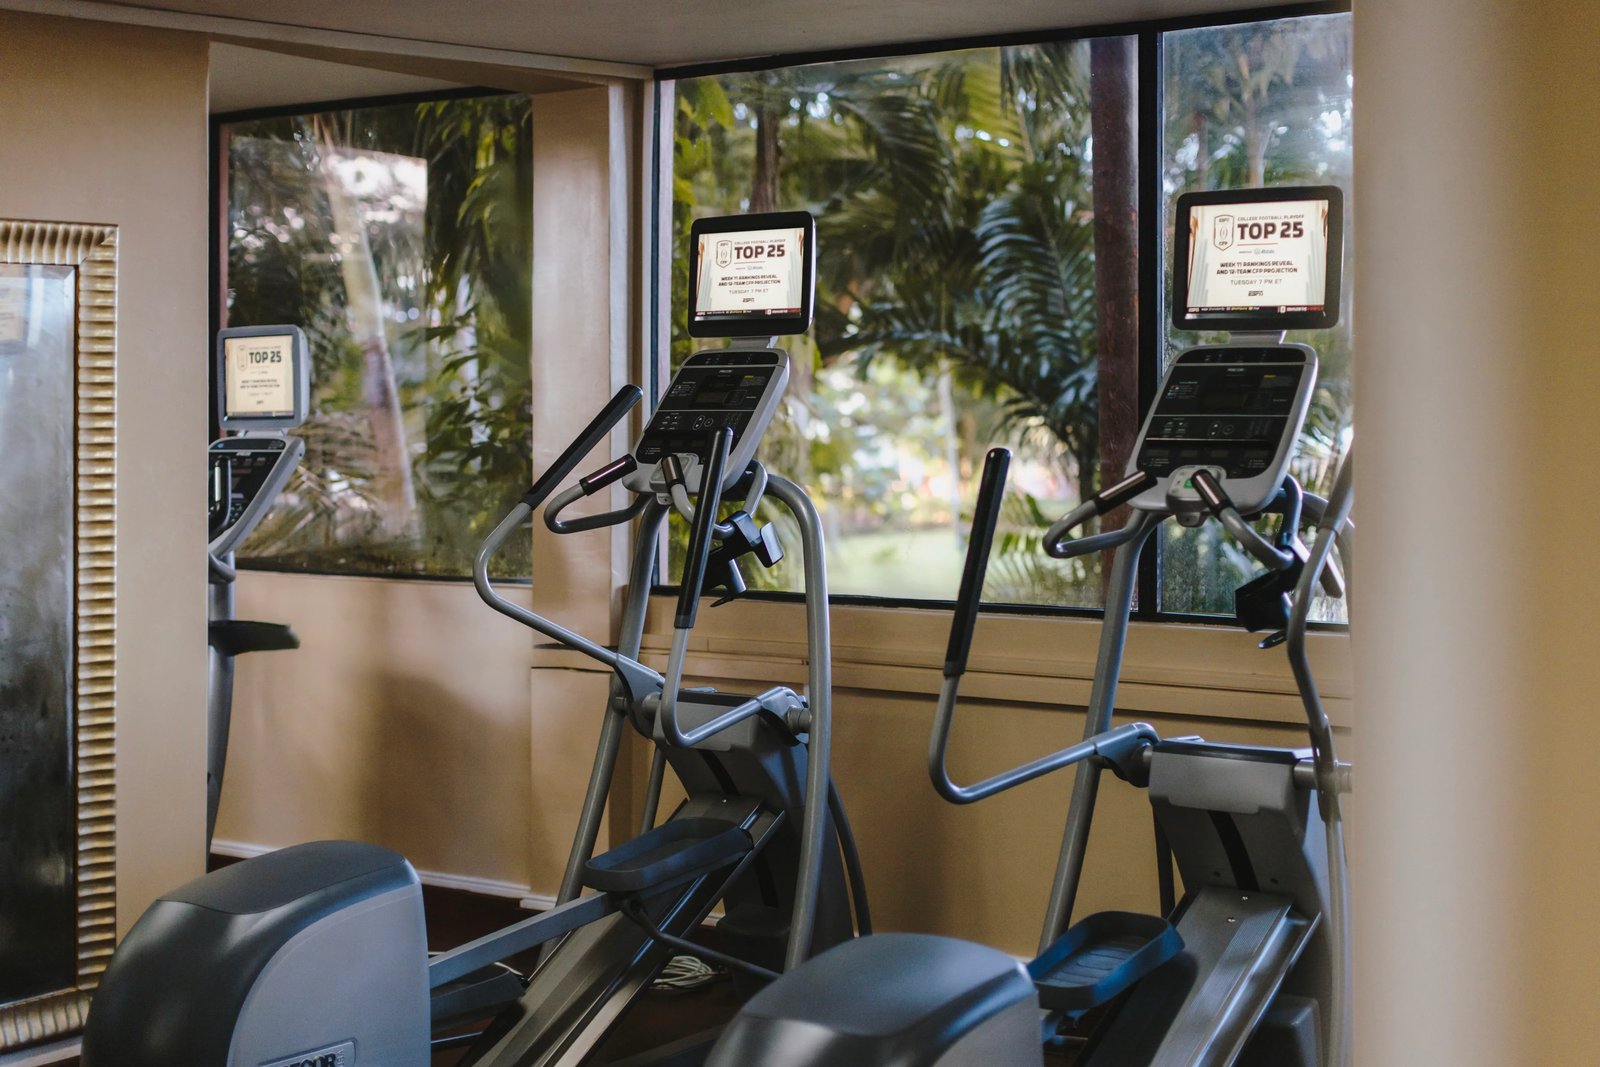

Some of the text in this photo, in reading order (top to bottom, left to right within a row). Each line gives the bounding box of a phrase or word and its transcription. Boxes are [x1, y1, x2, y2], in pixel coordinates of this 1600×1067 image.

[1237, 221, 1304, 240] TOP 25
[734, 244, 786, 259] TOP 25
[249, 351, 282, 364] TOP 25
